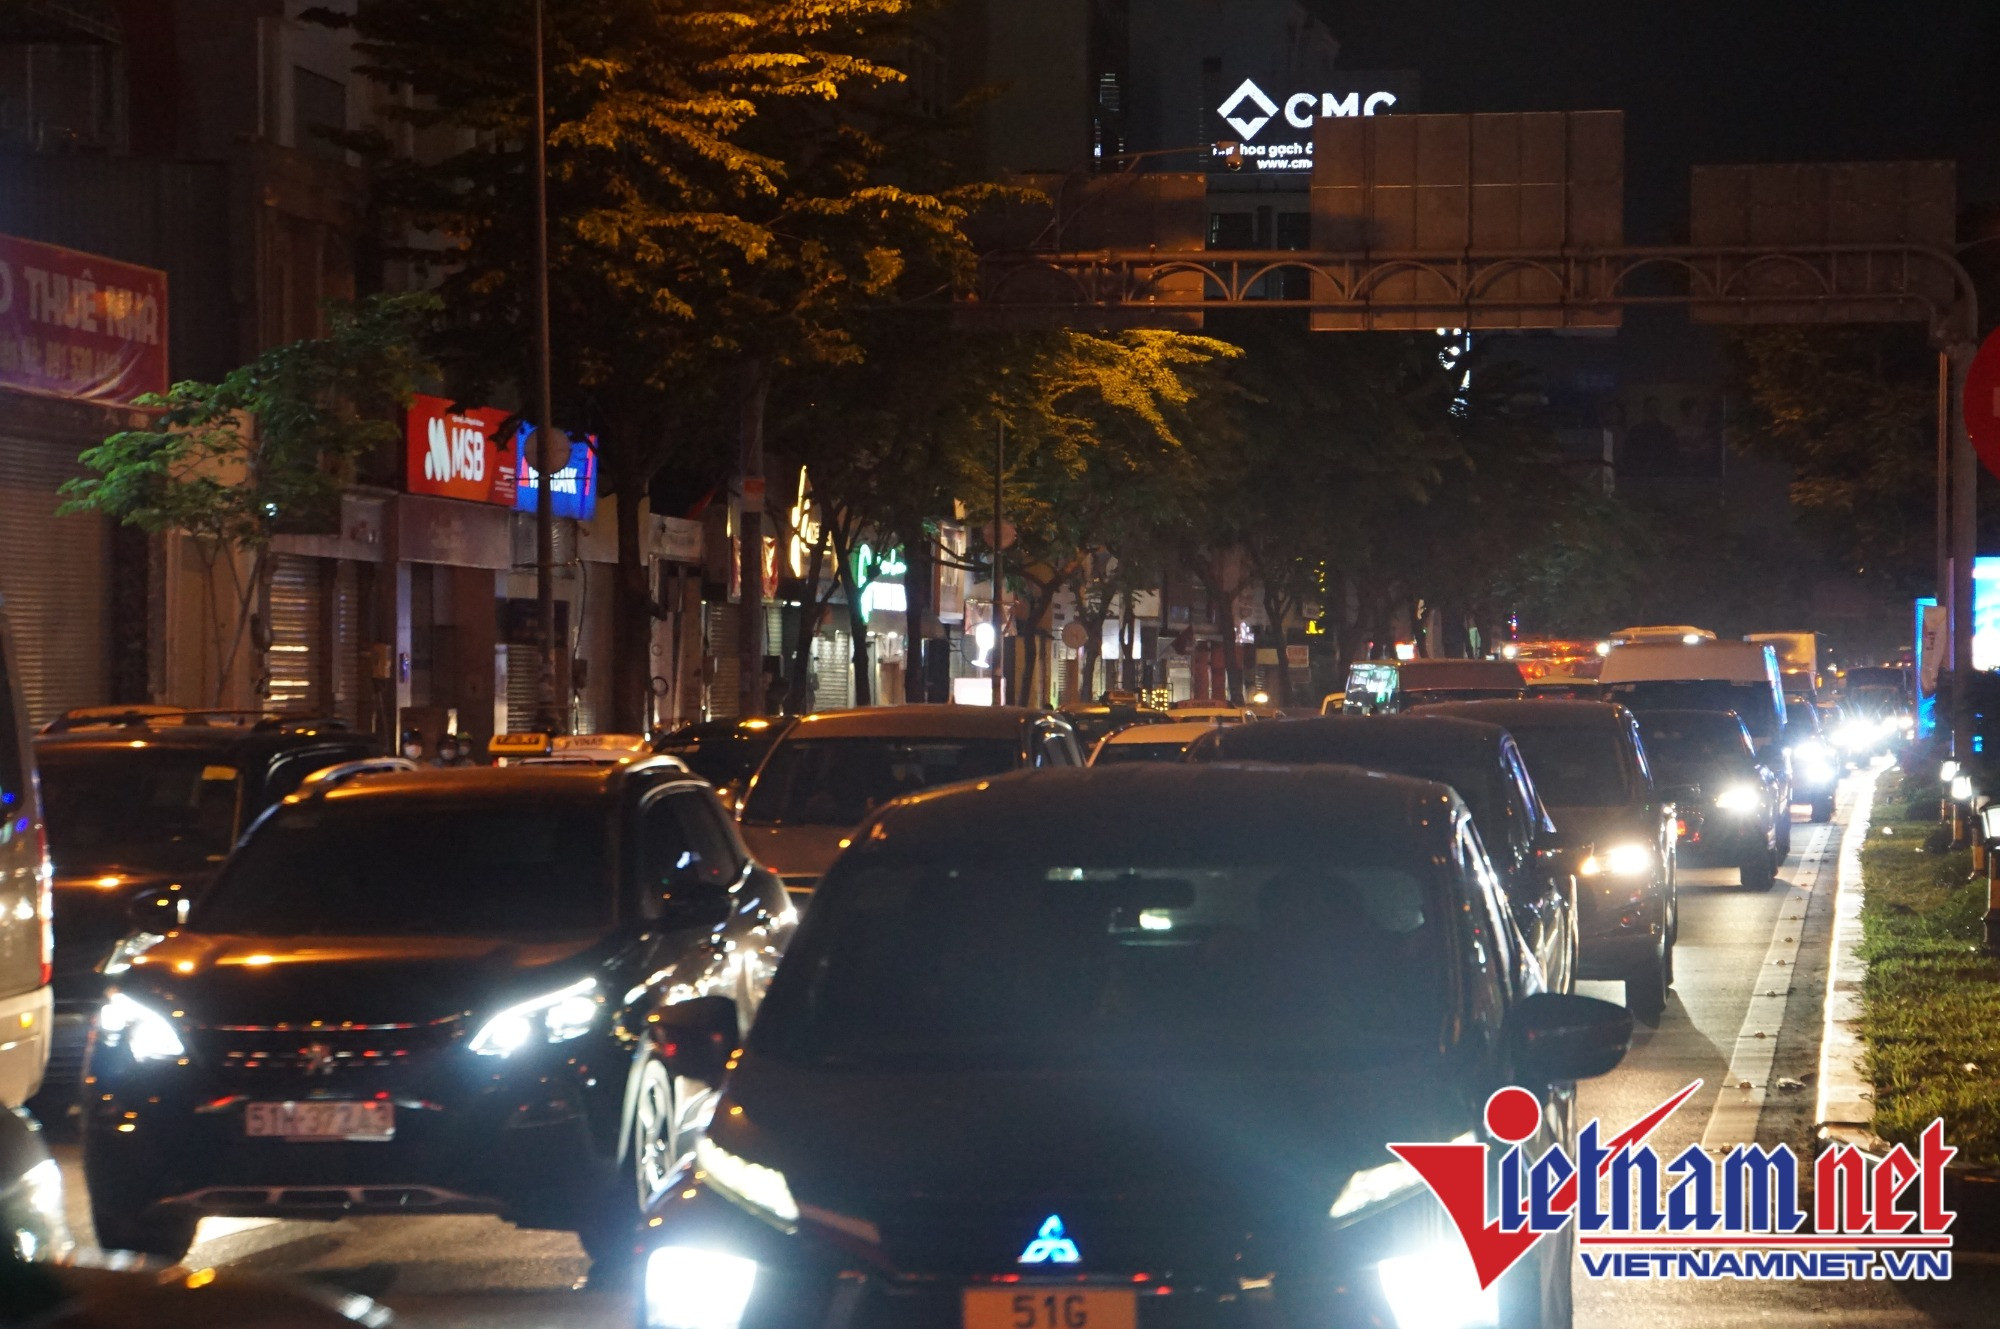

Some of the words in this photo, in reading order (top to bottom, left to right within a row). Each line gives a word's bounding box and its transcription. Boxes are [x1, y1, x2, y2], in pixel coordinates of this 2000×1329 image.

[1239, 143, 1265, 155] hoa
[1257, 159, 1313, 169] www.cm
[23, 266, 98, 333] THUÊ
[105, 283, 159, 345] NHÀ
[452, 427, 485, 482] MSB
[1011, 1294, 1088, 1329] 51G
